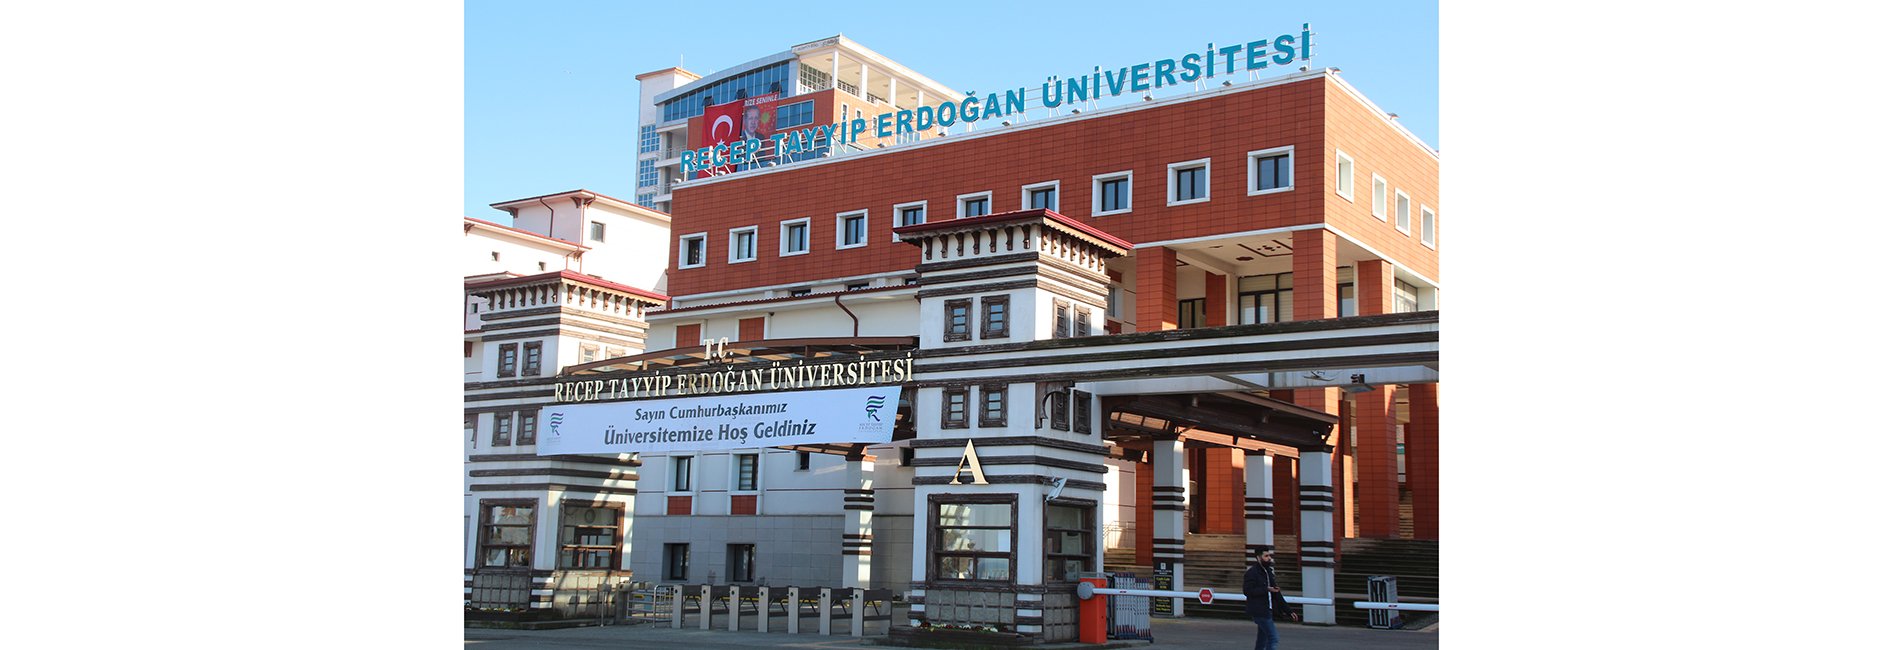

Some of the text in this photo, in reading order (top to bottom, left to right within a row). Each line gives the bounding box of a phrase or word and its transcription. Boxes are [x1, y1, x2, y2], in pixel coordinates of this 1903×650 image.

[680, 22, 1310, 173] RECEP TAYYİP ERDOĞAN ÜNİVERSİTESİ
[703, 336, 734, 360] T.C.
[554, 352, 914, 402] RECEP TAYYİP ERDOĞAN ÜNİVERSİTESİ
[604, 418, 817, 445] Üniversitemize Hoş Geldiniz
[635, 402, 788, 424] Sayın Cumhurbaşkanımız
[949, 438, 990, 485] A
